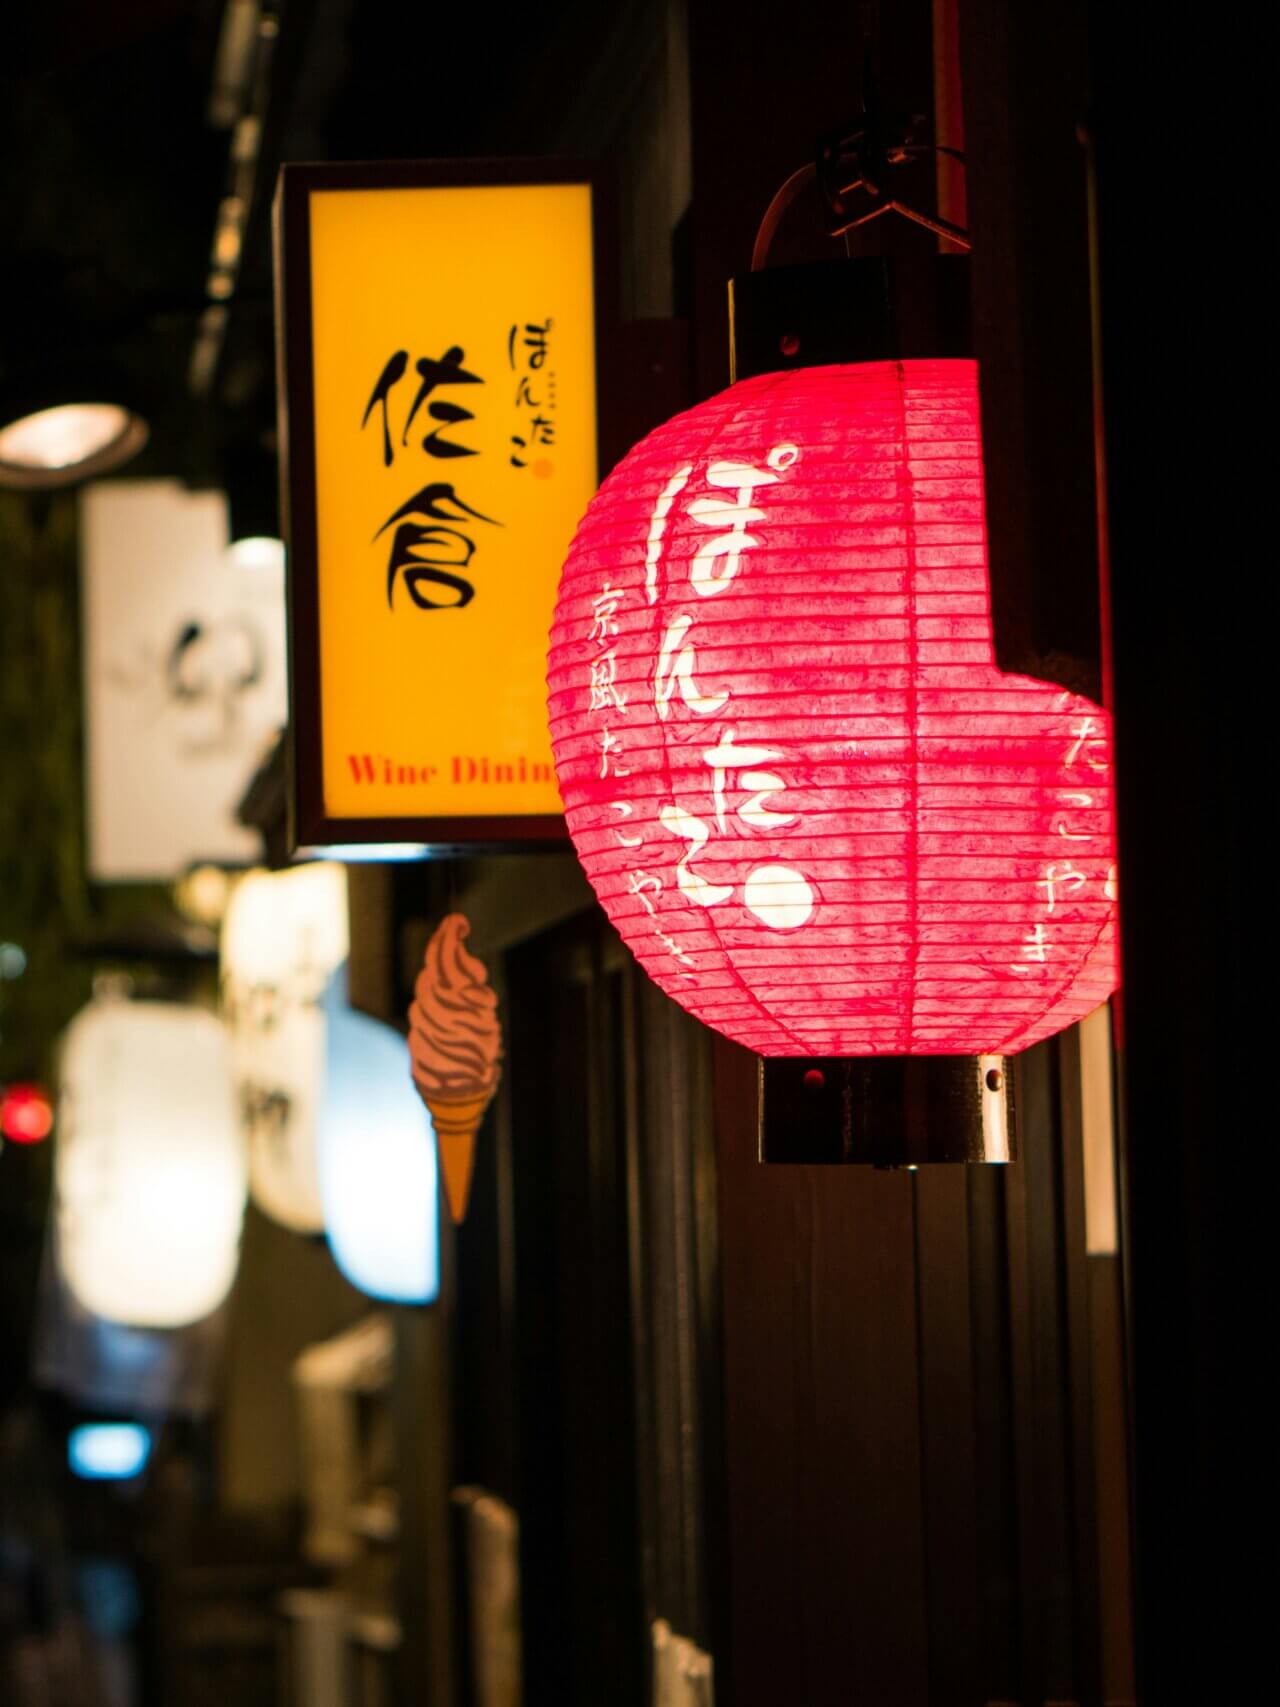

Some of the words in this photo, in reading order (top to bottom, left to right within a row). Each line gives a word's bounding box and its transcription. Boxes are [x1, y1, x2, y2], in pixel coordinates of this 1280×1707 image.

[348, 755, 438, 785] Wine
[452, 755, 554, 785] Dinin
[588, 582, 696, 982] 京風たこやき
[648, 443, 800, 908] ぽんたこ
[1010, 690, 1108, 973] たこやき
